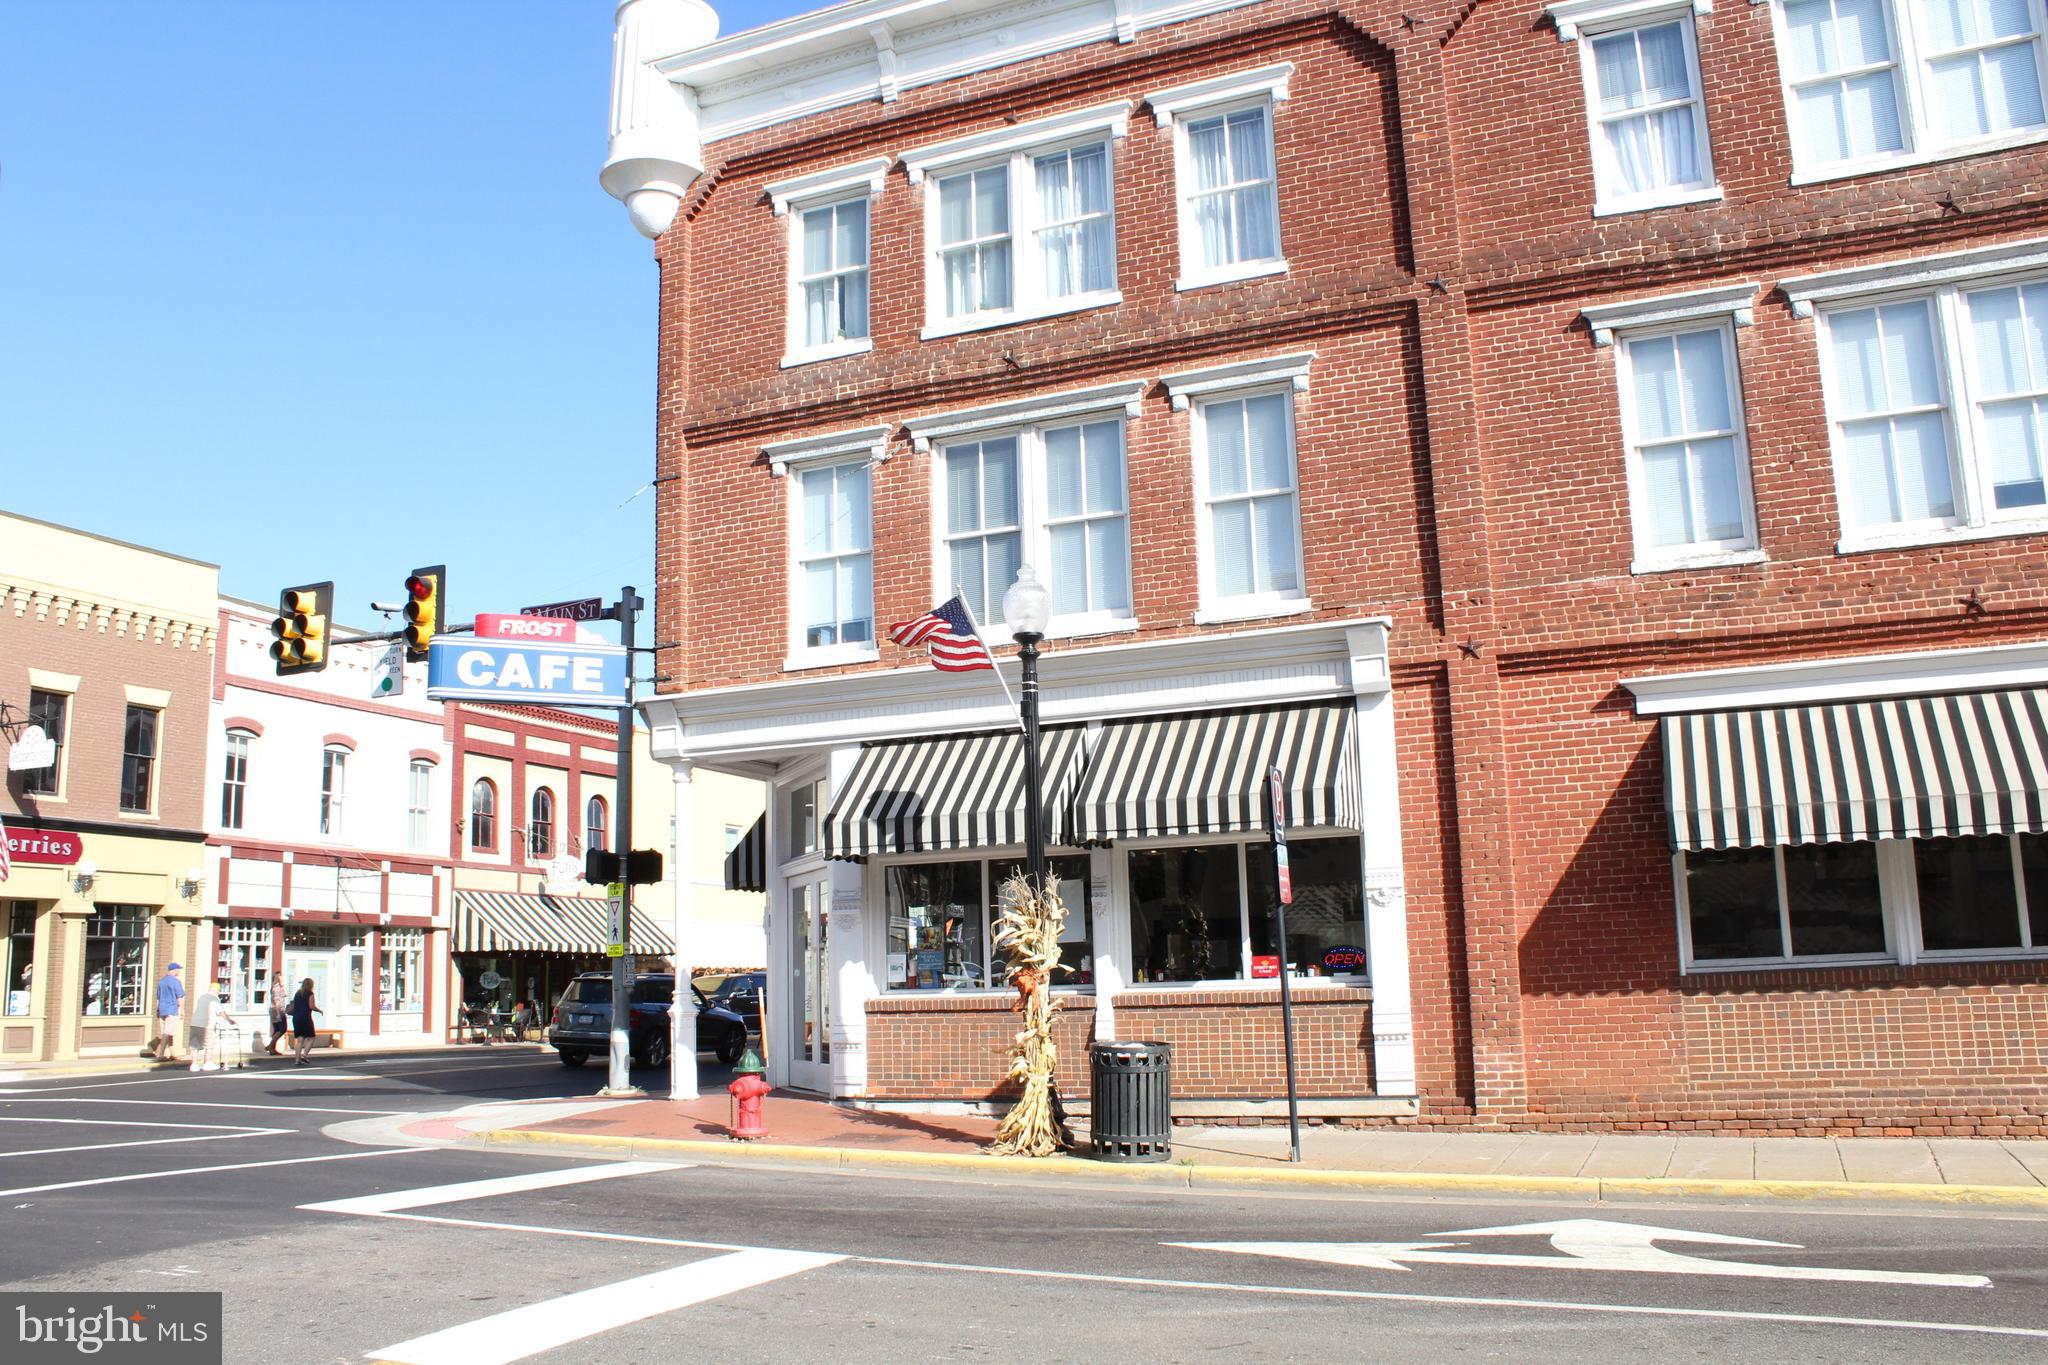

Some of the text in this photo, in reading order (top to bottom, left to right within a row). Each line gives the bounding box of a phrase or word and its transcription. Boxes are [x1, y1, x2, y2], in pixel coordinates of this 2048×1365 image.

[578, 602, 597, 620] ST
[498, 618, 567, 637] FROST
[456, 650, 604, 693] CAFE
[1324, 953, 1365, 965] OPEN
